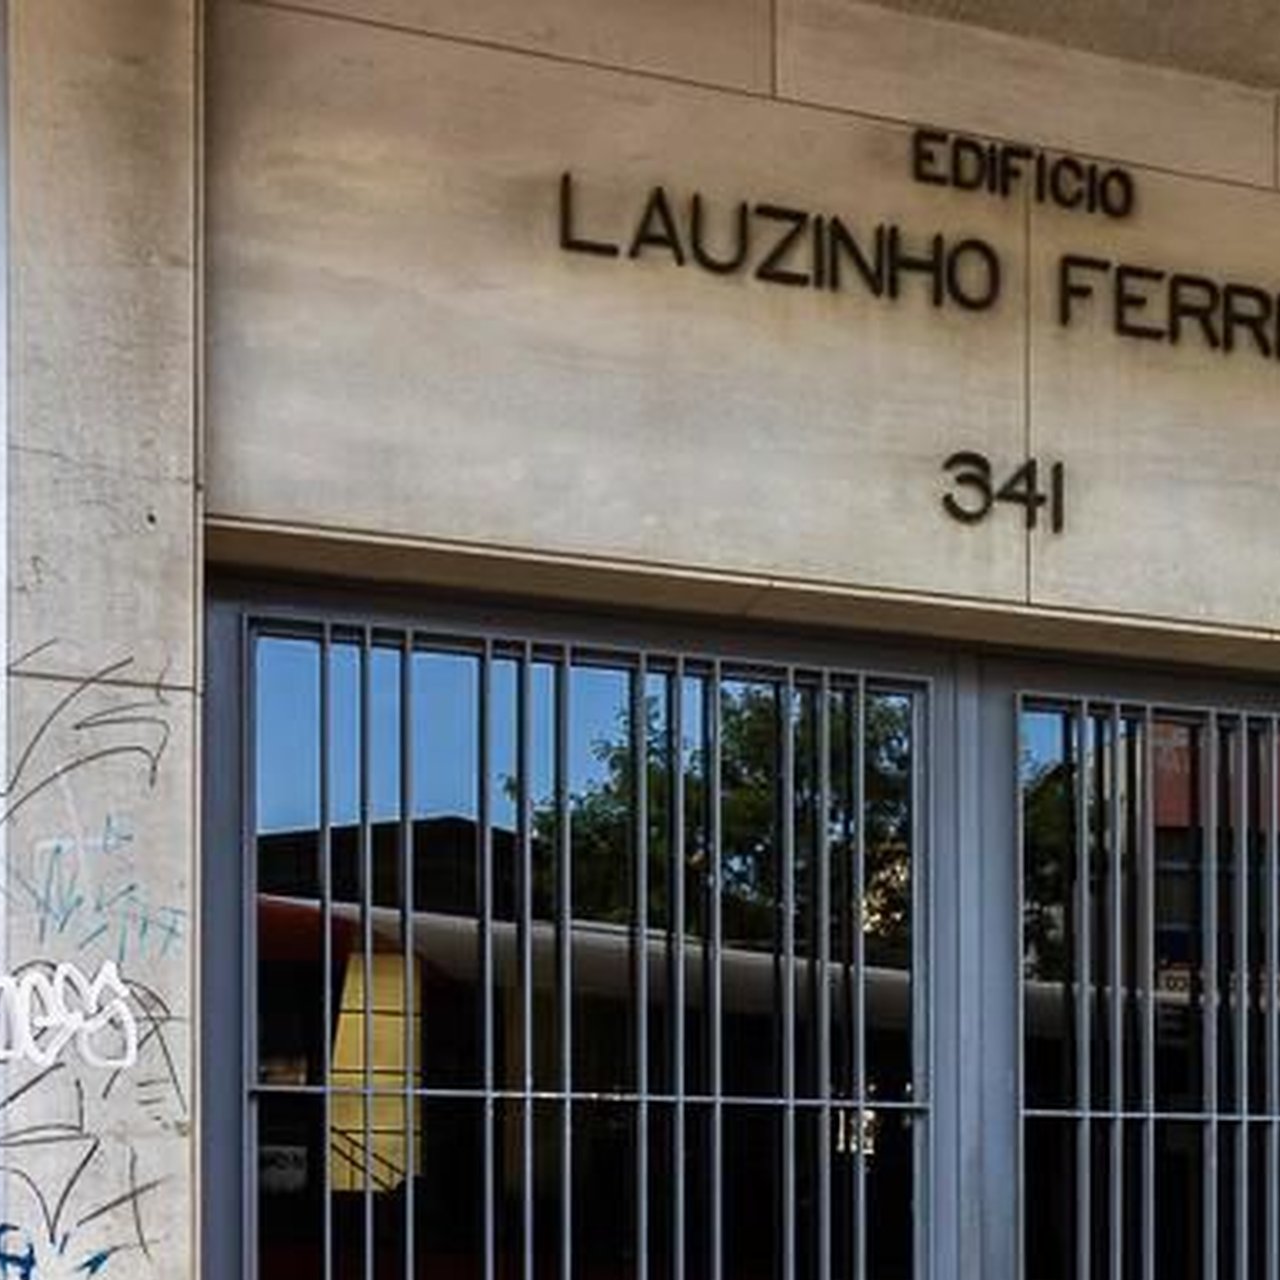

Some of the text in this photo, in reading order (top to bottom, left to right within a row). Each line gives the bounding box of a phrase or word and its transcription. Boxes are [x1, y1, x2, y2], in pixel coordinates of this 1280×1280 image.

[911, 128, 1135, 218] EDIFICIO
[559, 171, 1001, 311] LAUZINHO
[942, 451, 1064, 534] 341
